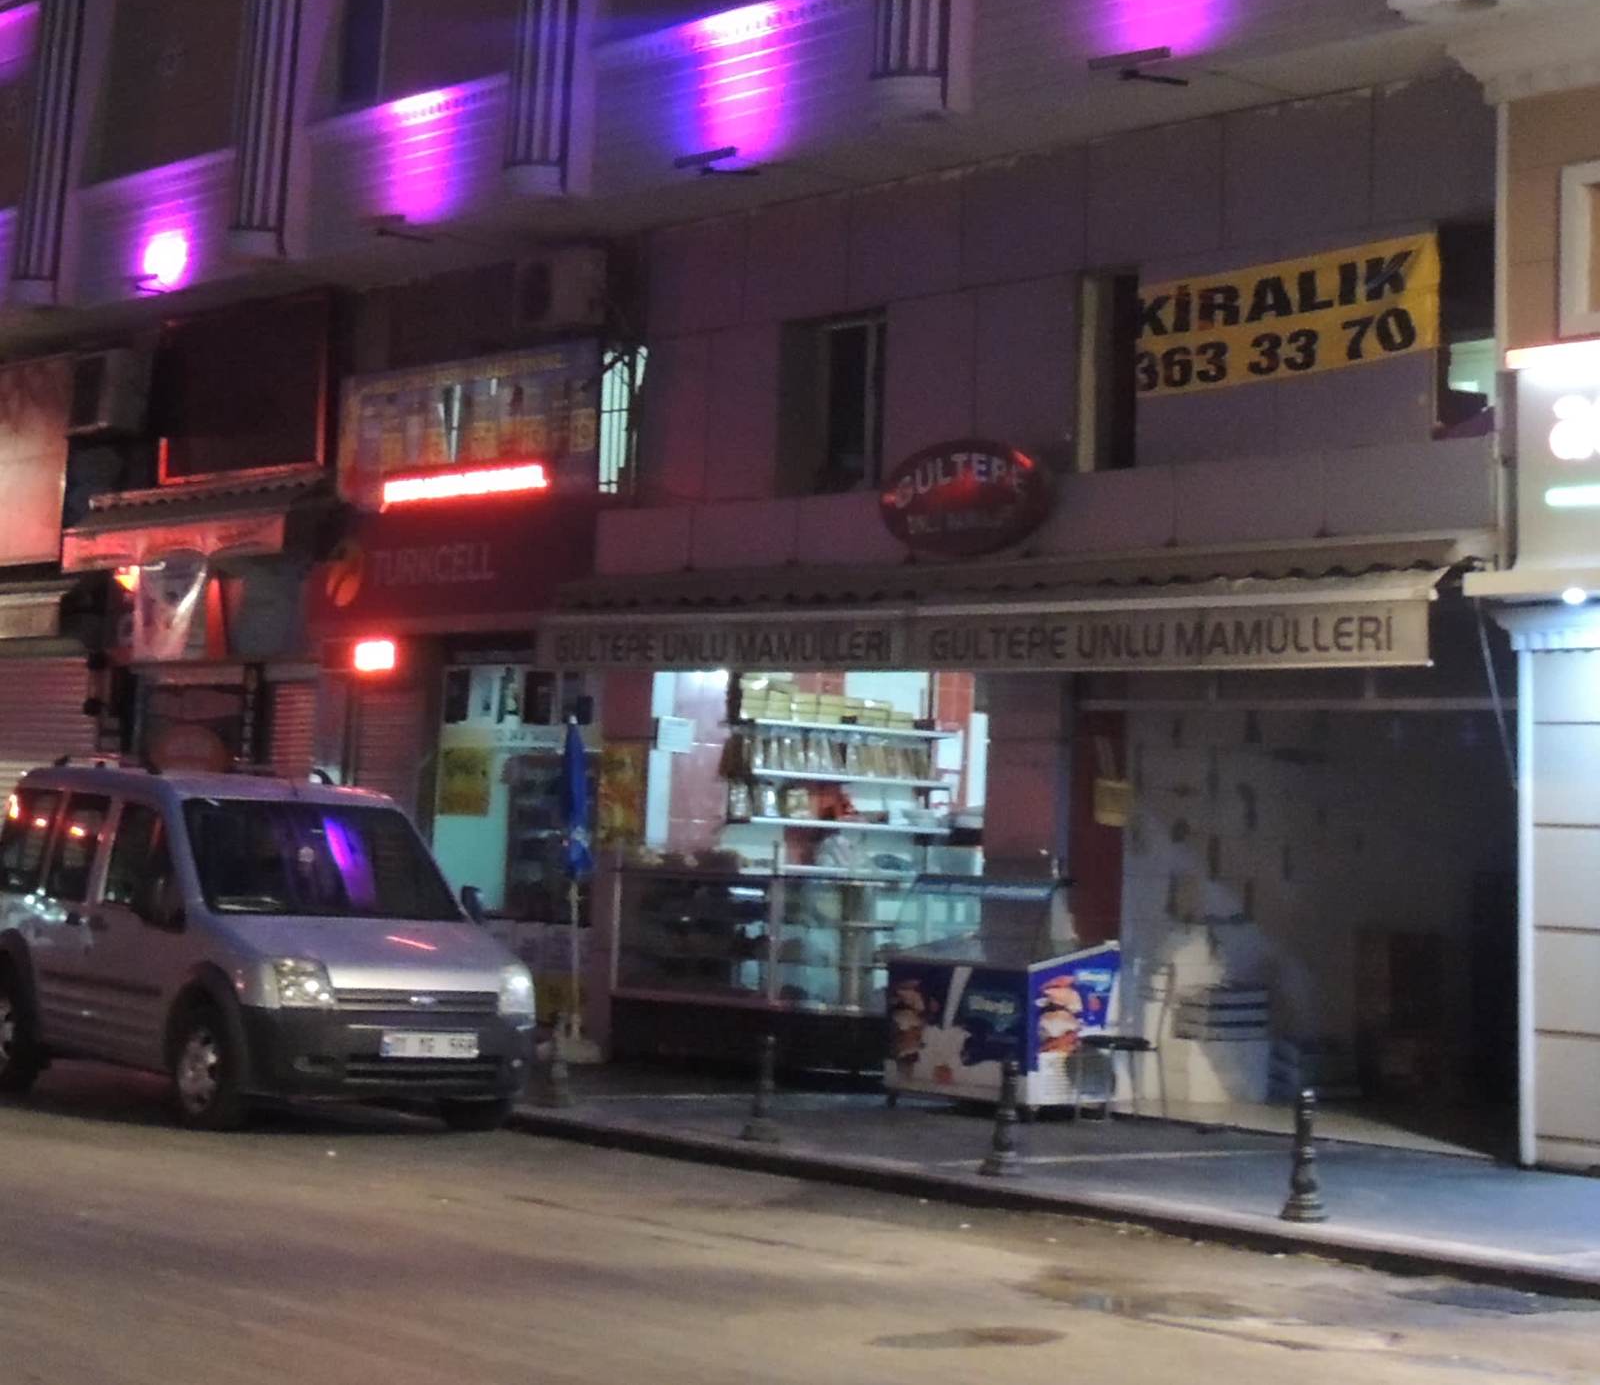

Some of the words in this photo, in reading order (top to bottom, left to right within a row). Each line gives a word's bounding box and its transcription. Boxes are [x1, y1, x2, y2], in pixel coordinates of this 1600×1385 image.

[1135, 341, 1229, 392] 363
[1247, 329, 1319, 376] 33
[1342, 307, 1416, 360] 70
[1075, 622, 1165, 659] UNLU
